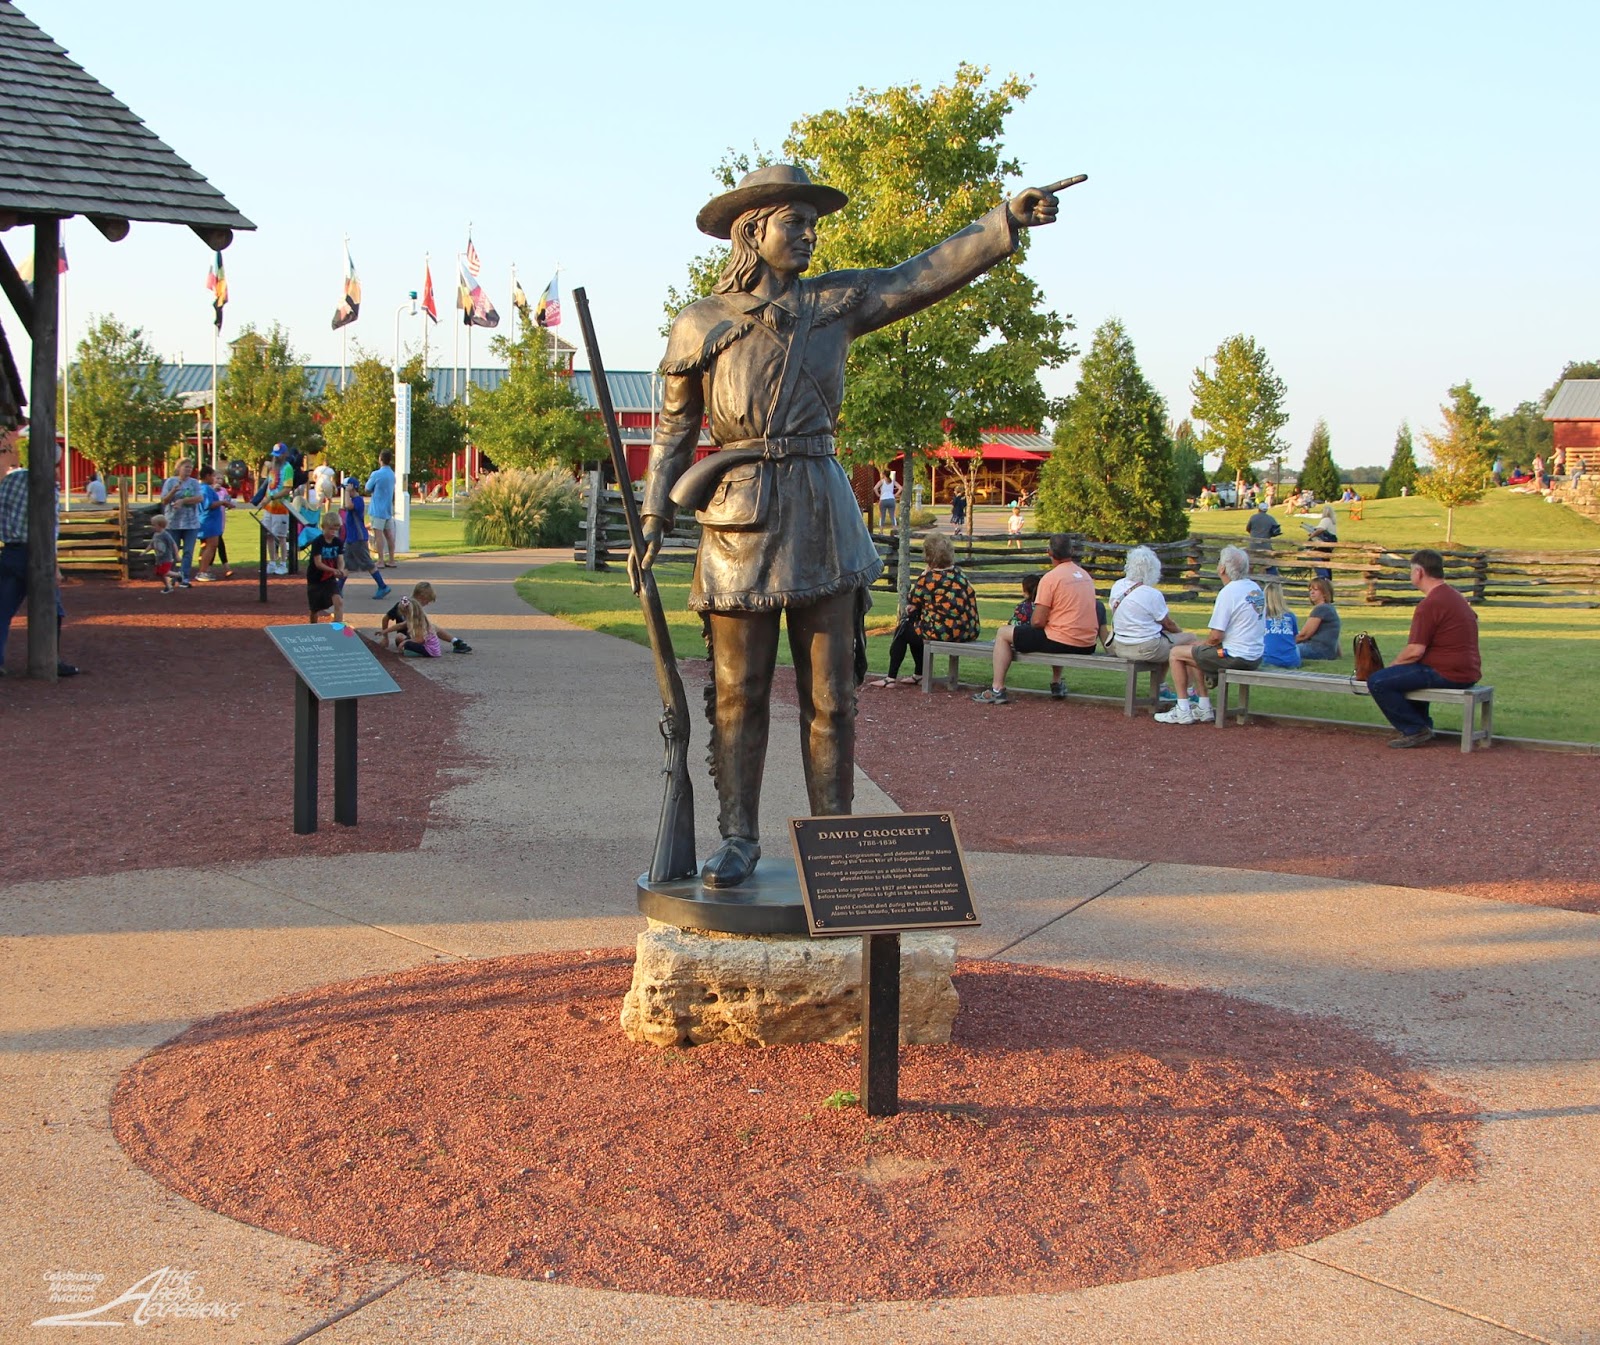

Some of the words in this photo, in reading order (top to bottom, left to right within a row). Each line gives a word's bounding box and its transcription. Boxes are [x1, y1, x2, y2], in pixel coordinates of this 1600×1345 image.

[282, 636, 297, 644] The
[818, 830, 859, 840] DAVID
[864, 826, 931, 838] CROCKETT
[868, 908, 890, 916] Antonio,
